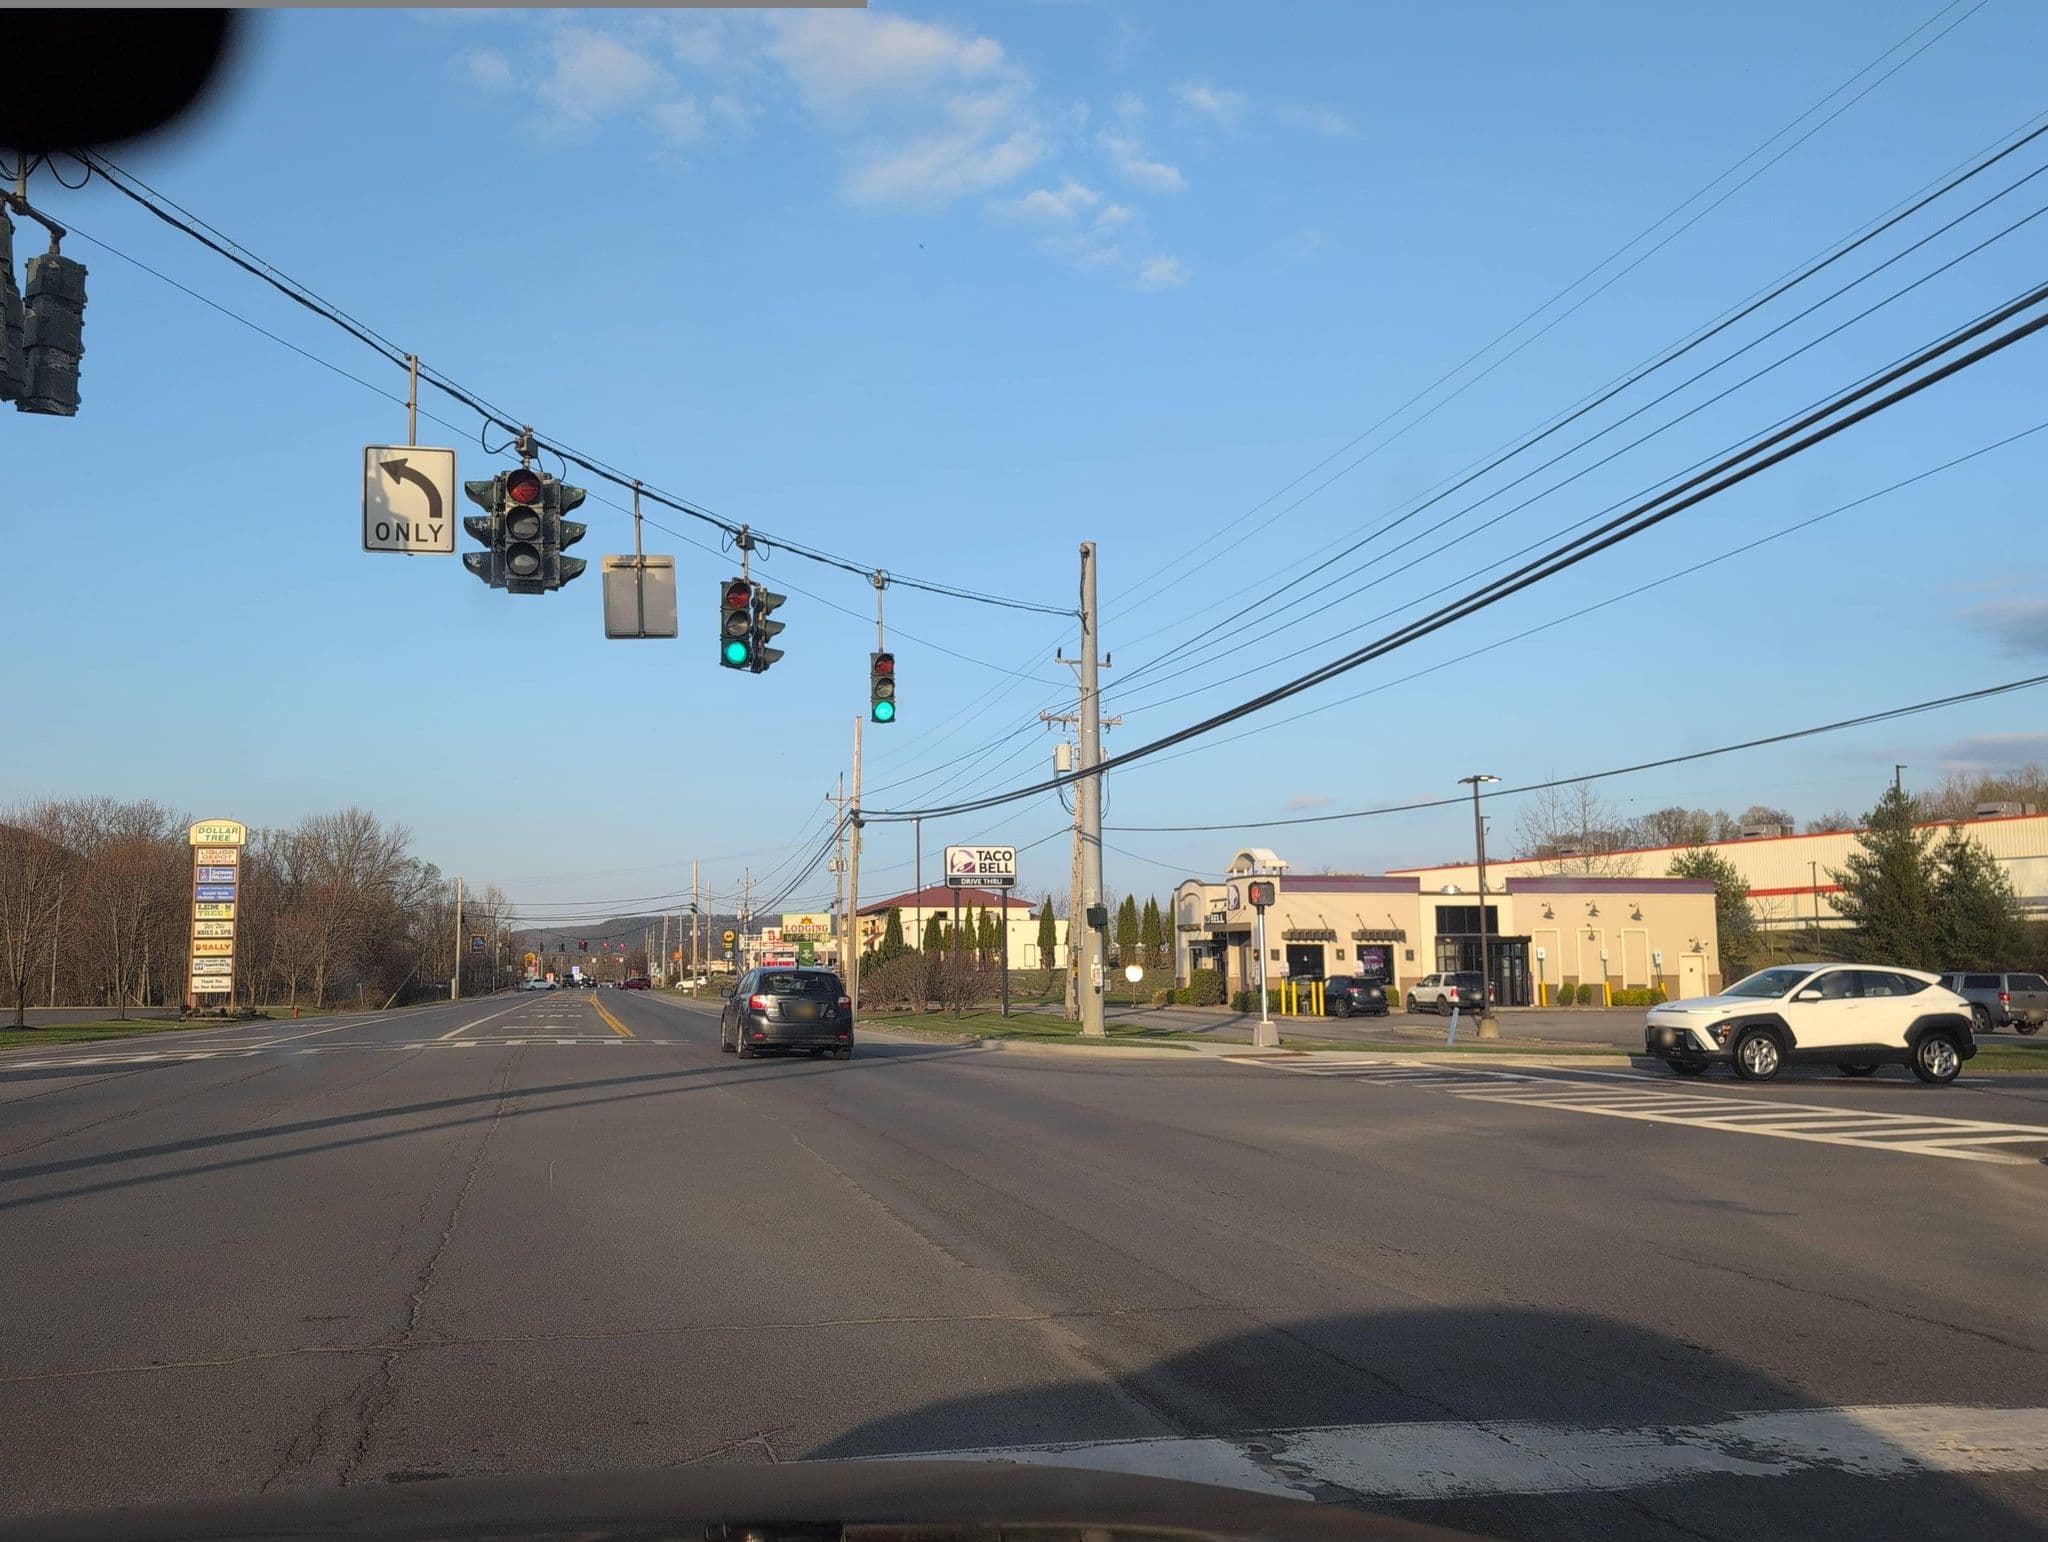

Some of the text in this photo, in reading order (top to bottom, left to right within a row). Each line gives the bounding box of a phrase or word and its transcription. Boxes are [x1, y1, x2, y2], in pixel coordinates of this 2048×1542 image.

[375, 522, 443, 542] ONLY
[205, 834, 231, 842] TREE
[976, 850, 1013, 862] TACO
[979, 863, 1013, 874] BELL
[785, 924, 828, 933] LODGING
